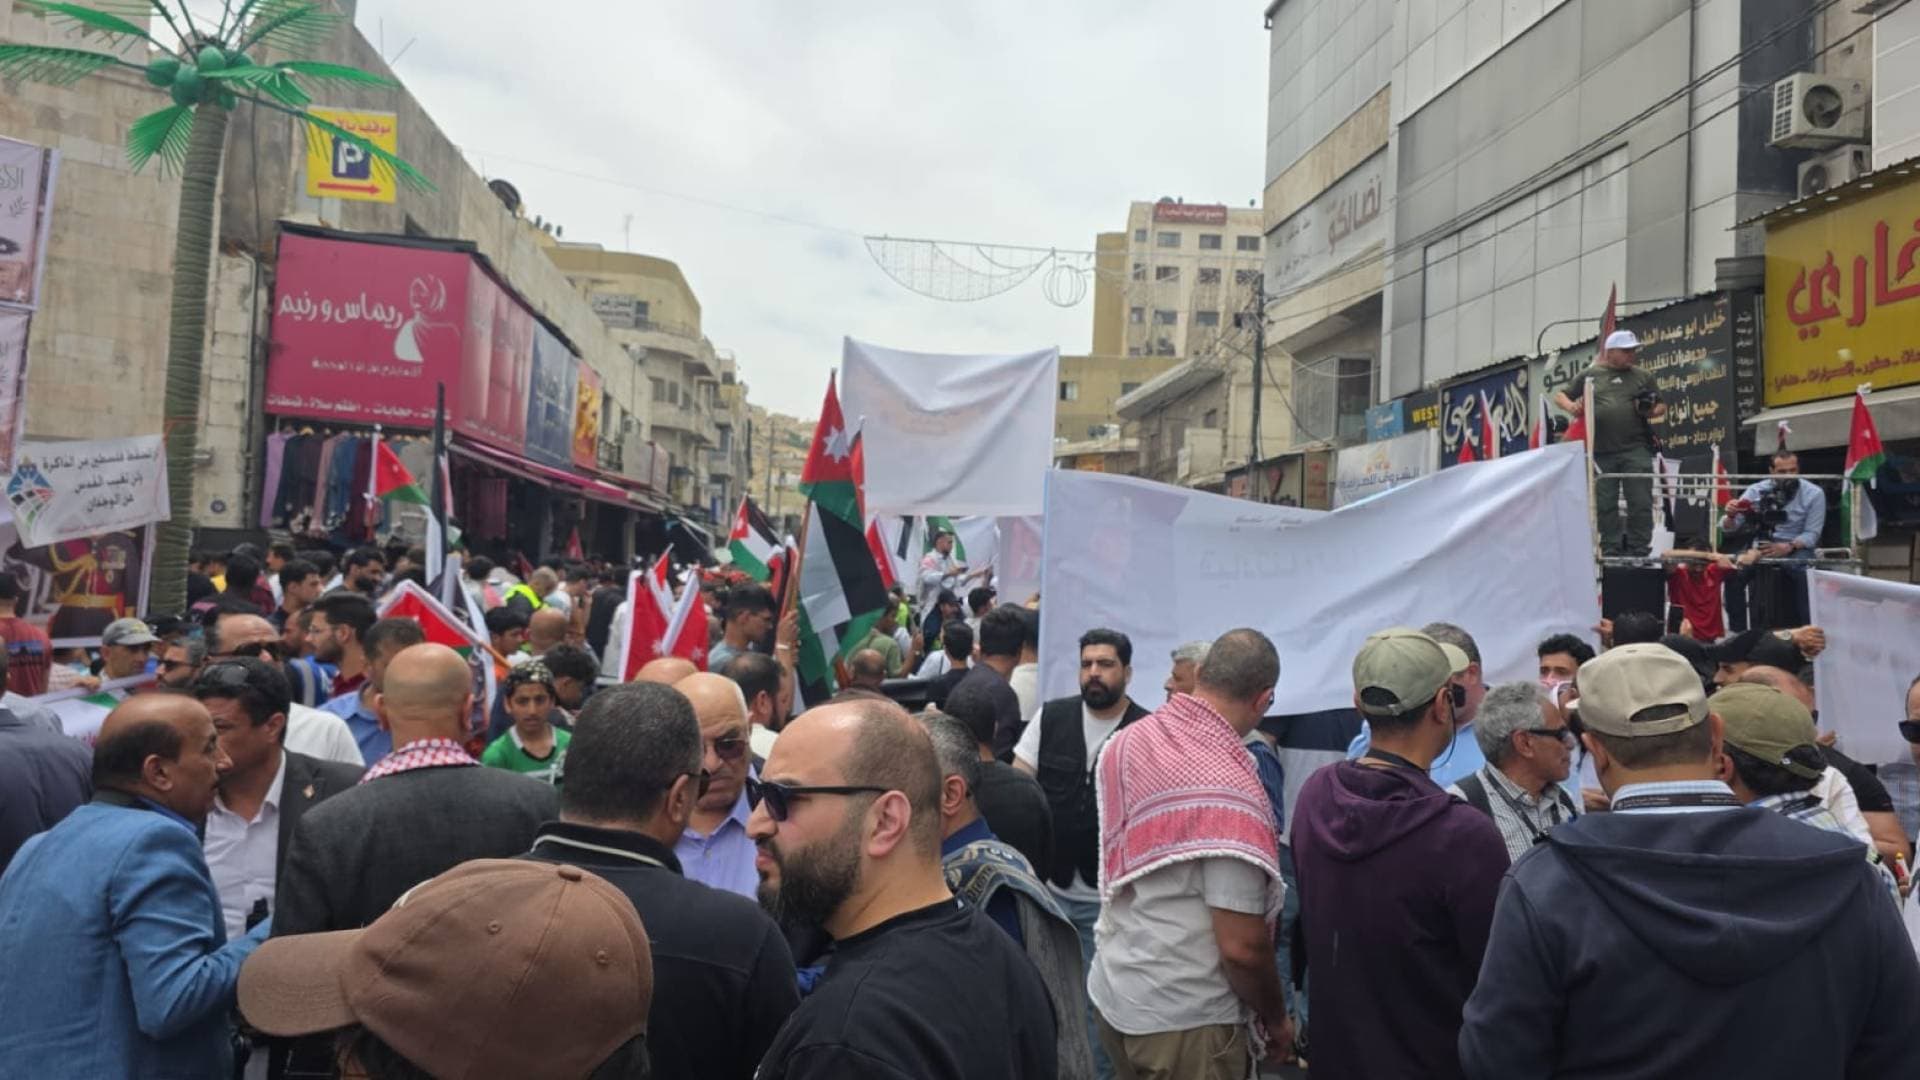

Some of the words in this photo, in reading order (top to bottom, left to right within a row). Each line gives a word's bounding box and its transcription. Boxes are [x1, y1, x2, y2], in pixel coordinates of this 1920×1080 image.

[359, 121, 391, 135] موقف
[338, 141, 364, 174] P
[279, 290, 318, 323] رنيم
[321, 299, 333, 323] و
[336, 292, 403, 329] ريماس
[1698, 309, 1727, 336] خليل
[1692, 400, 1720, 425] جميع
[42, 455, 75, 471] الذاكرة
[74, 475, 103, 495] القدس
[87, 493, 121, 513] الوجدان
